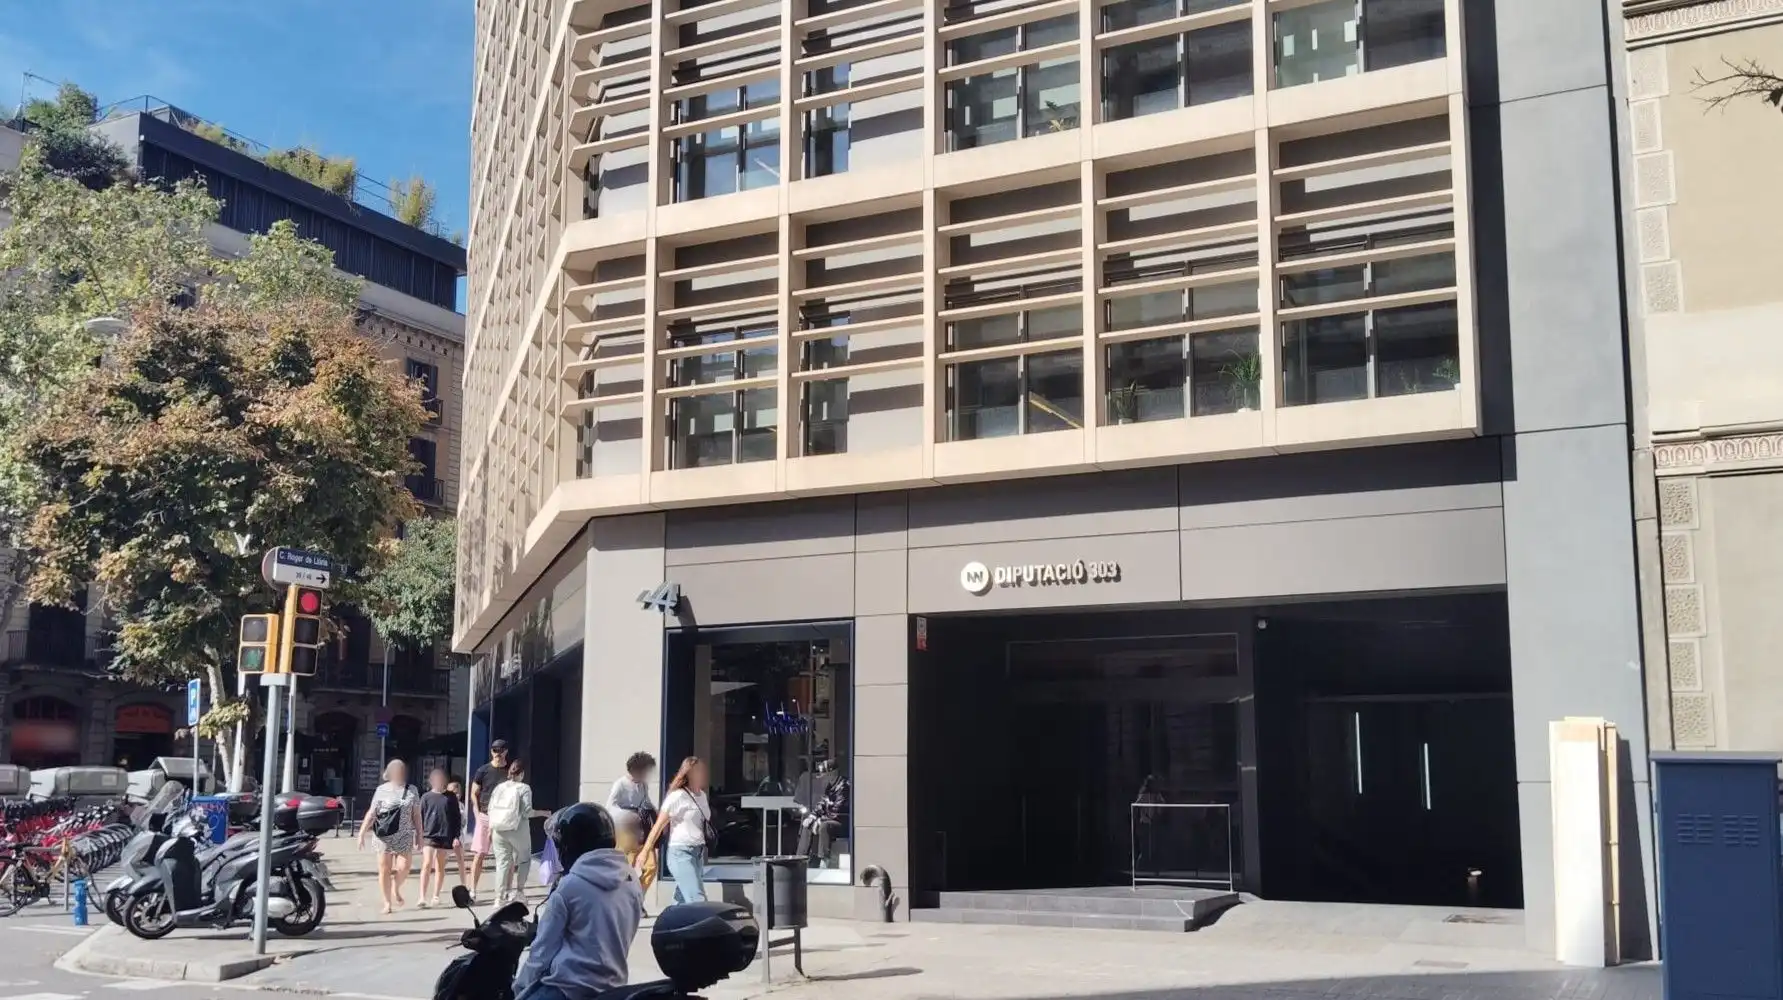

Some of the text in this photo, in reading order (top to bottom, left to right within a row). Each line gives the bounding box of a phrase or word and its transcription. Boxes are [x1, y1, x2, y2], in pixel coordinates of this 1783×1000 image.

[287, 552, 304, 564] Roger
[305, 555, 313, 564] de
[994, 559, 1119, 584] DIPUTACIÓ 303
